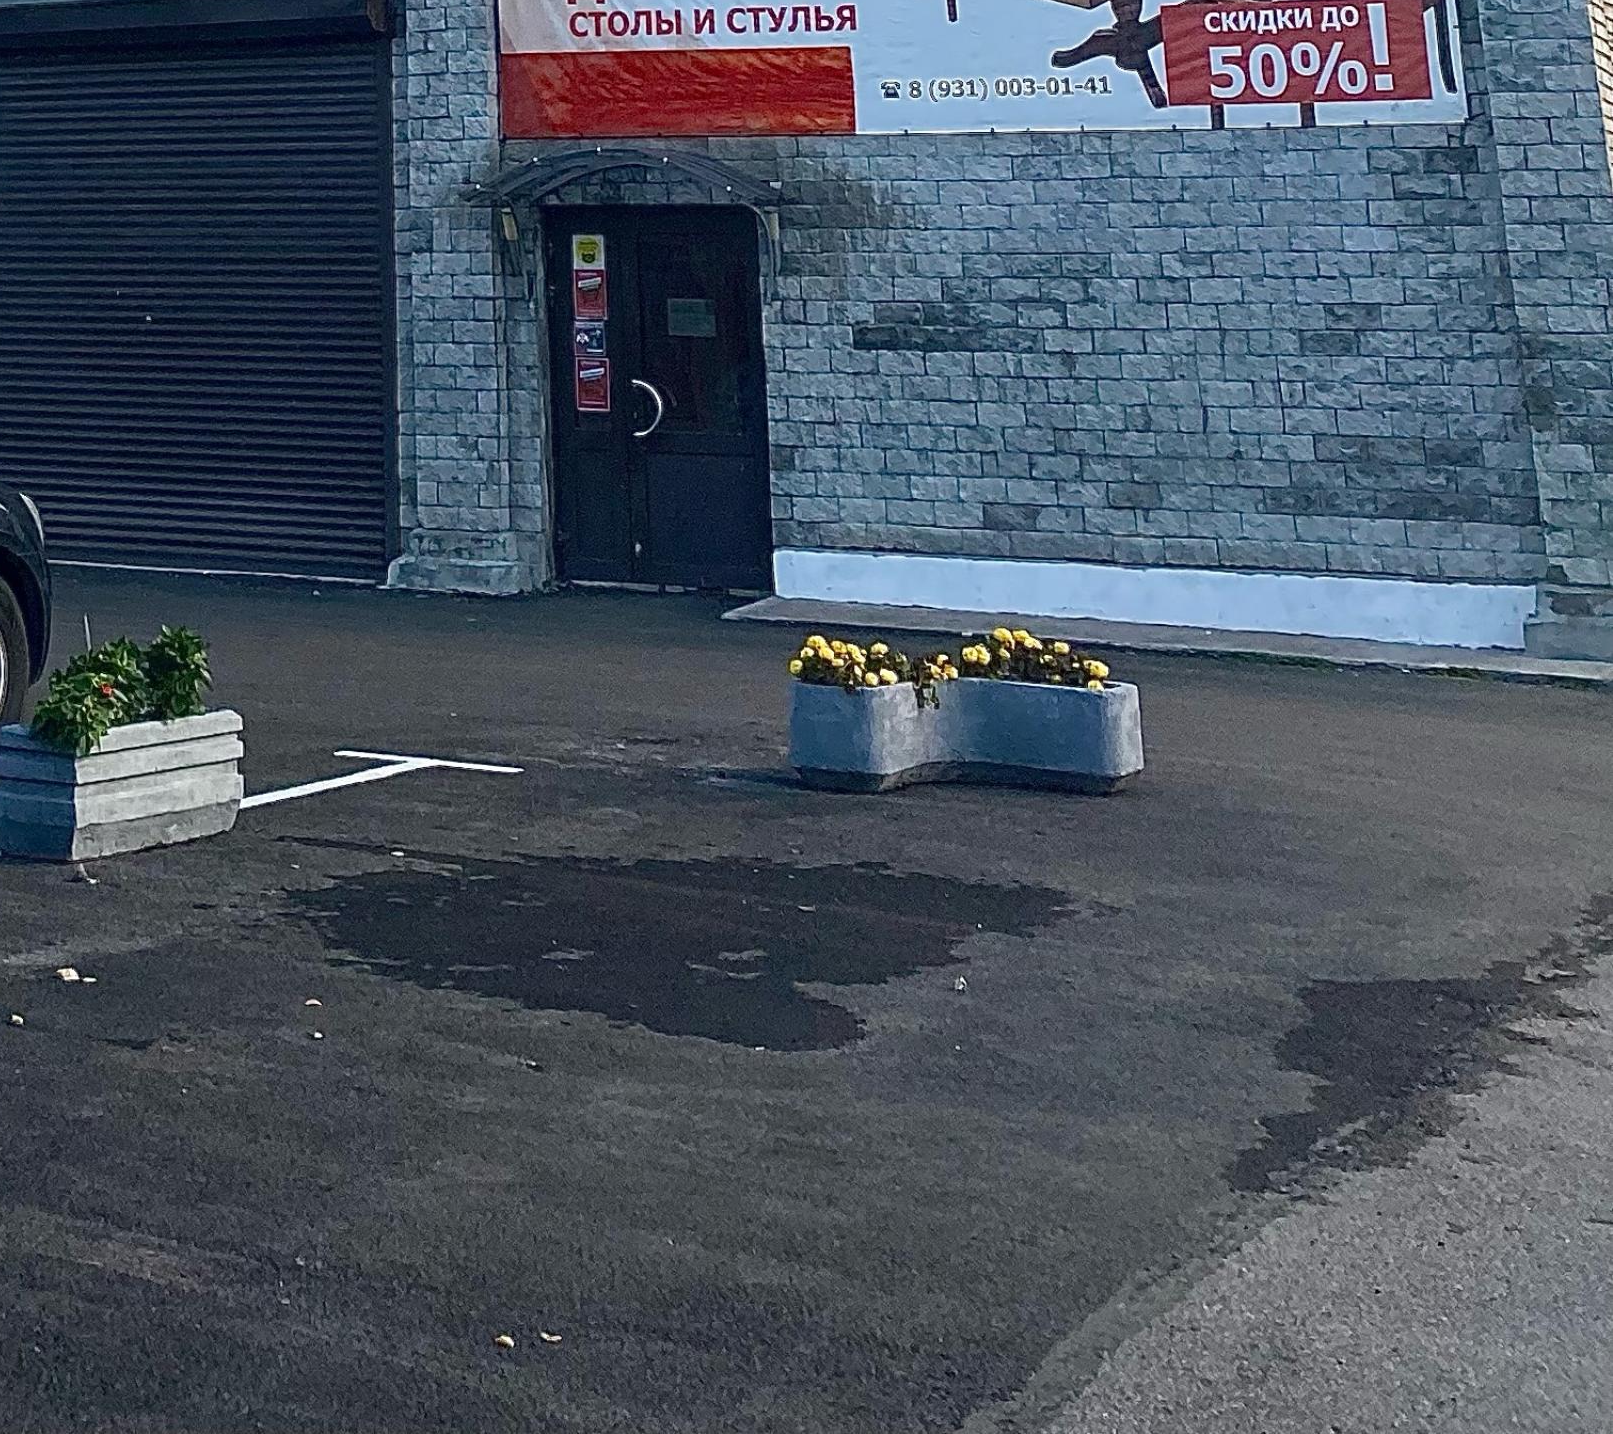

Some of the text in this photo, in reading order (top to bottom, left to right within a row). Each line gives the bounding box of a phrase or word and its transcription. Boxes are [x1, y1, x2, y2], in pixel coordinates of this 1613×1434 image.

[568, 4, 857, 38] СТОЛЫ И СТУЛЬЯ
[1203, 5, 1360, 37] СКИДКИ ДО
[908, 75, 1113, 102] 8 (931) 003-01-41
